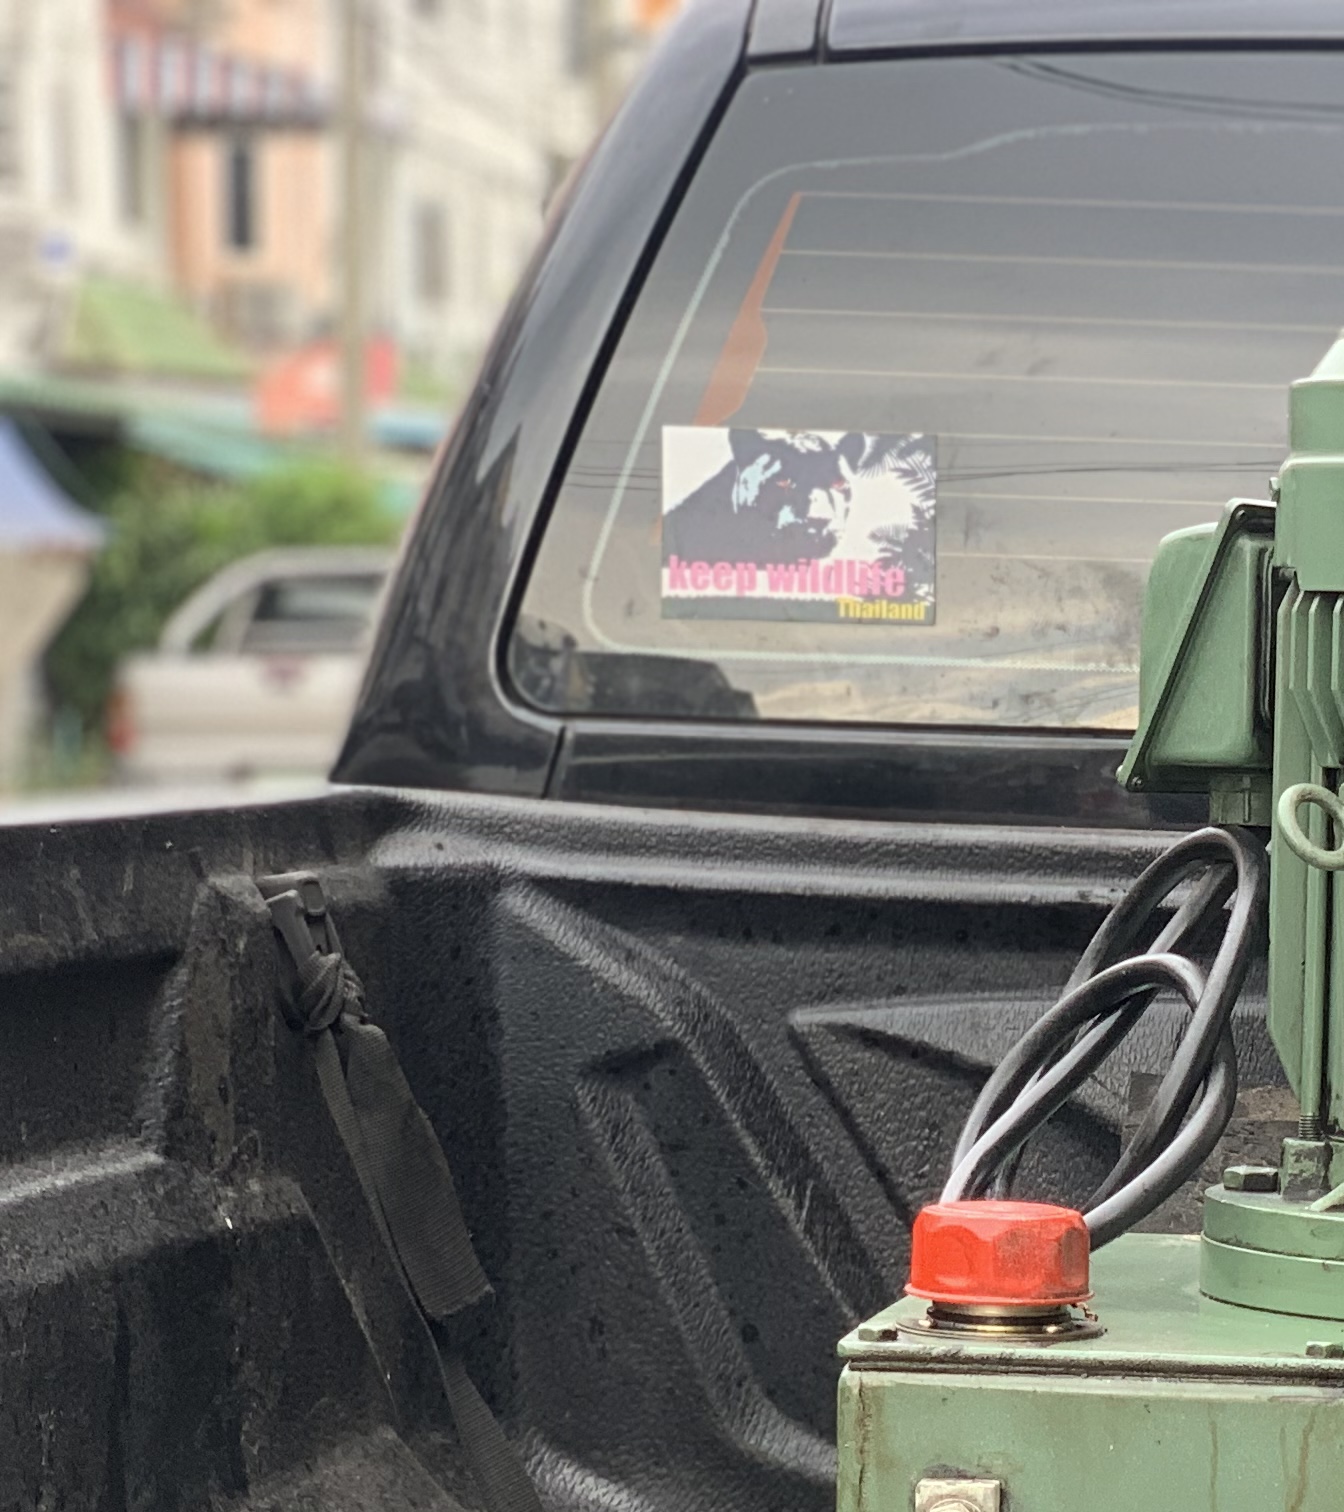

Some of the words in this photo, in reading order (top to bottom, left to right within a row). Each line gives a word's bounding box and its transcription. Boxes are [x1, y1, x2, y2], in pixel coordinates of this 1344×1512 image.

[668, 555, 757, 595] keep
[765, 558, 906, 597] wildlife
[836, 597, 927, 621] Thailand
